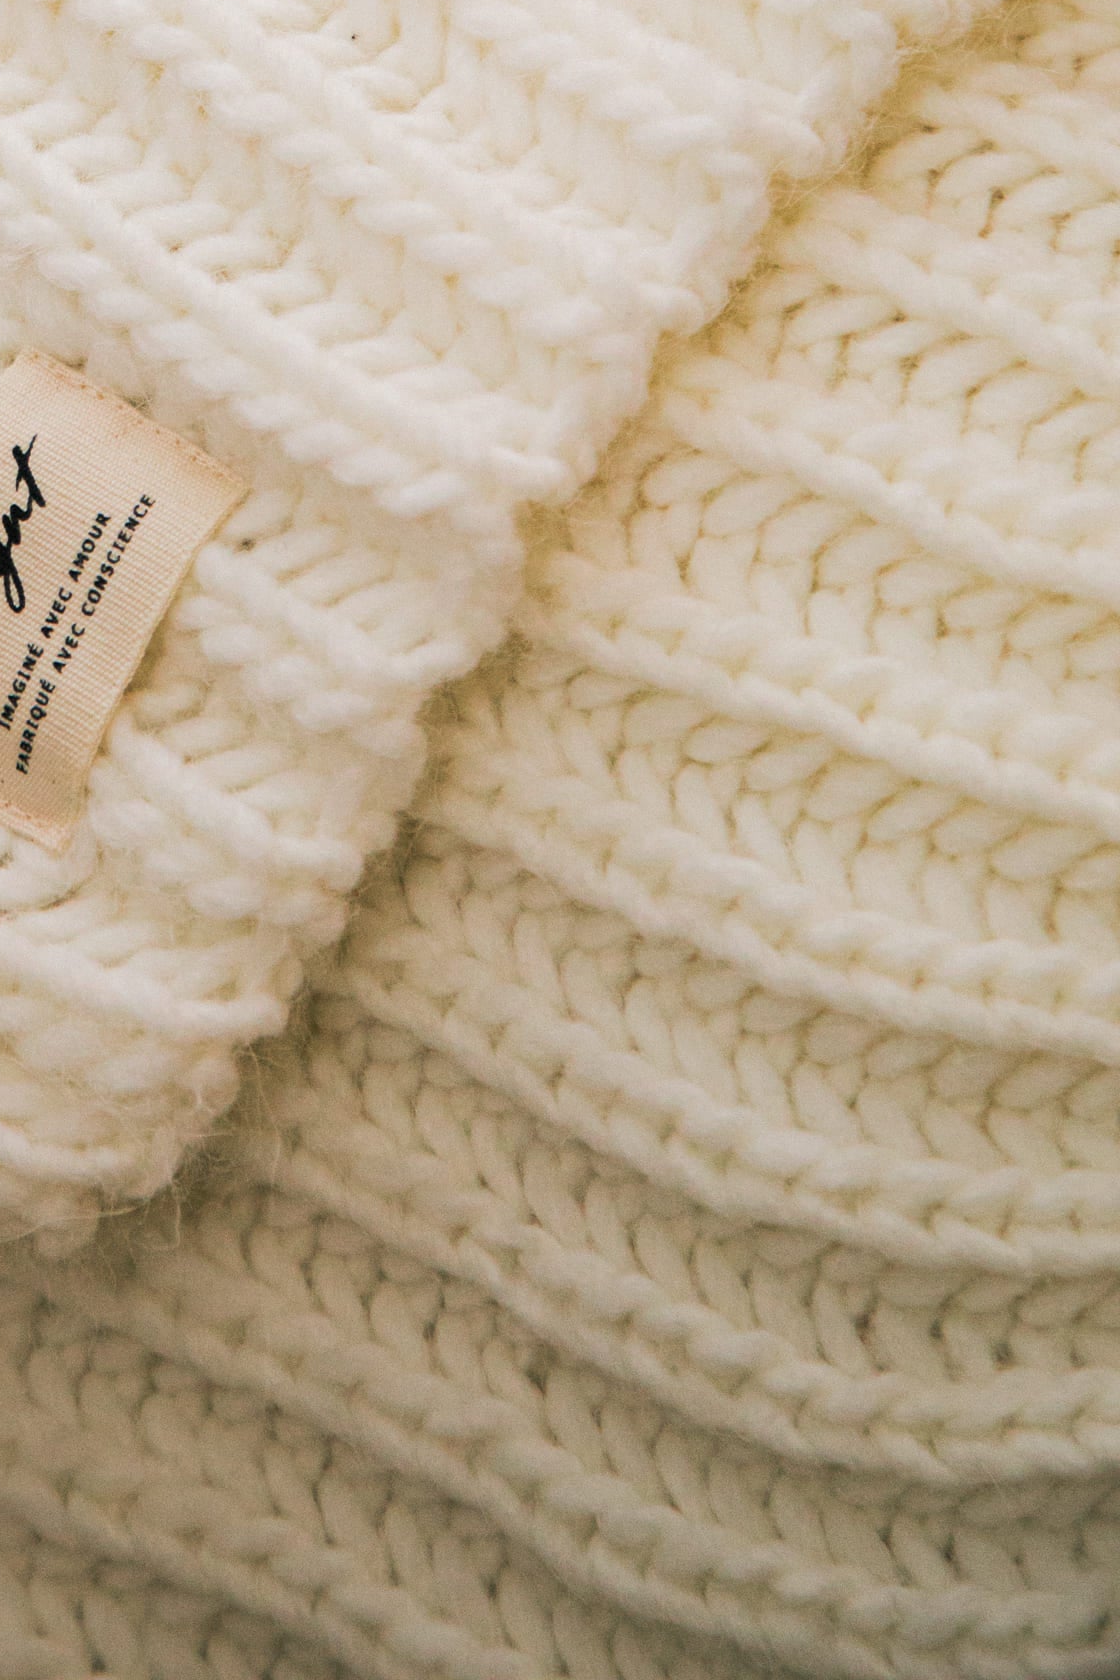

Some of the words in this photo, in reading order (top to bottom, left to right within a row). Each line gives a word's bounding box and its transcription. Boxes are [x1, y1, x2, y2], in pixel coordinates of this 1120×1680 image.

[16, 679, 56, 775] FABRIQUÉ
[52, 623, 85, 674] AVEC
[81, 494, 156, 617] CONSCIENCE
[41, 587, 73, 639] AVEC
[68, 512, 111, 583] AMOUR
